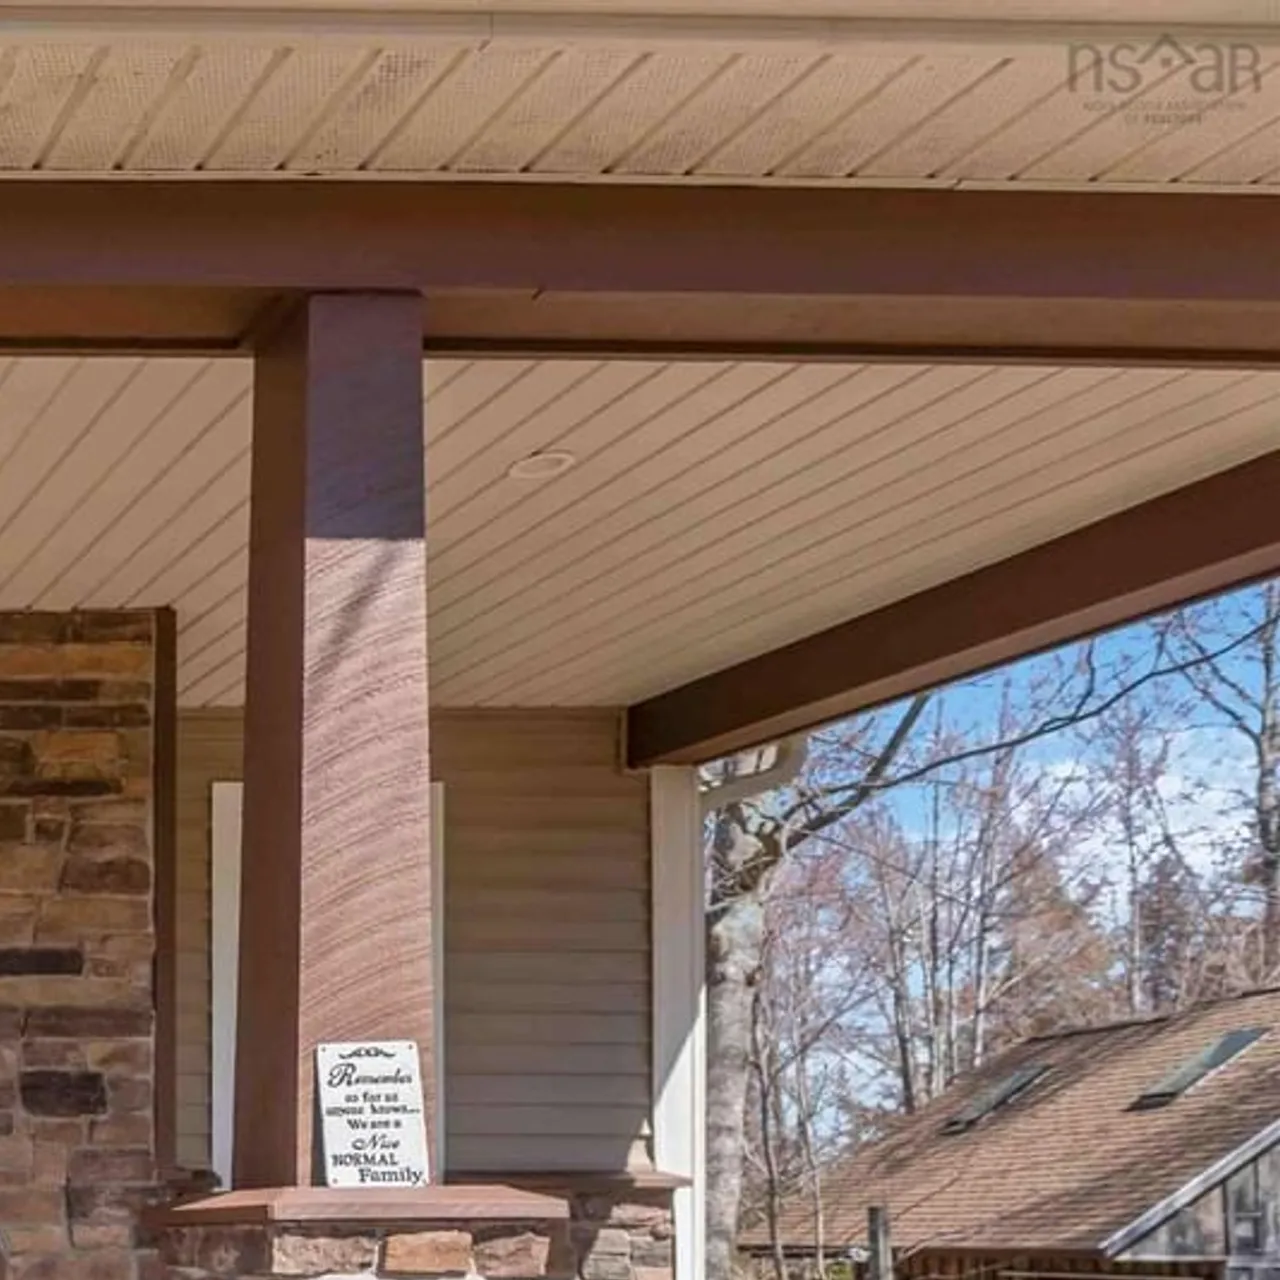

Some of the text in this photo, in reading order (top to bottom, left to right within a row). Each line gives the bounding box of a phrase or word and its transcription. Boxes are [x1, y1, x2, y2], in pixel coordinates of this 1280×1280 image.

[327, 1062, 413, 1088] Remember
[346, 1118, 367, 1130] We
[370, 1119, 391, 1130] are
[331, 1152, 399, 1167] NORMAL
[358, 1166, 423, 1186] Family
